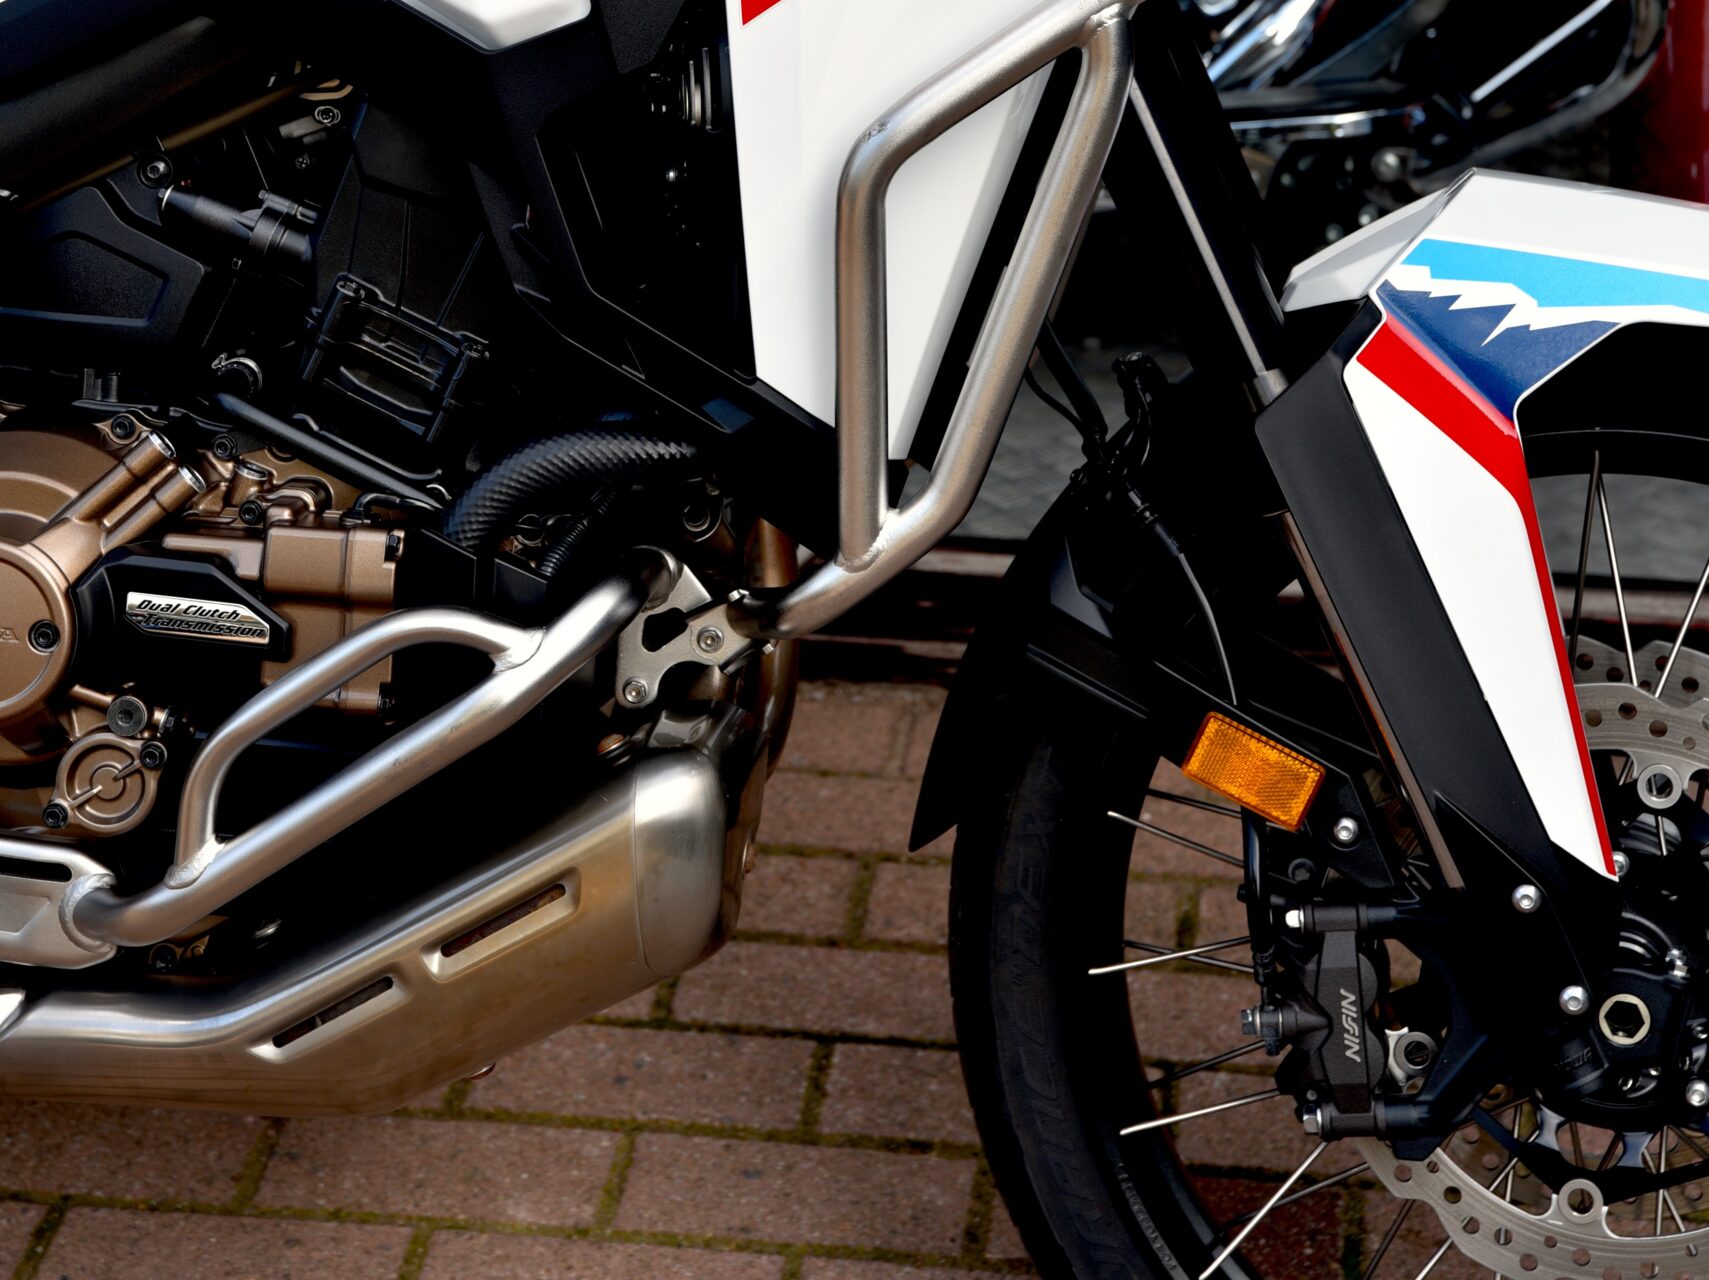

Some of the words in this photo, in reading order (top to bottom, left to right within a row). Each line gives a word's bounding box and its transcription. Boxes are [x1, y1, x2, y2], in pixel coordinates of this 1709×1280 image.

[137, 599, 180, 614] Dual
[183, 605, 242, 621] Clutch
[142, 613, 264, 637] Transmission
[1340, 988, 1361, 1062] NISSIN
